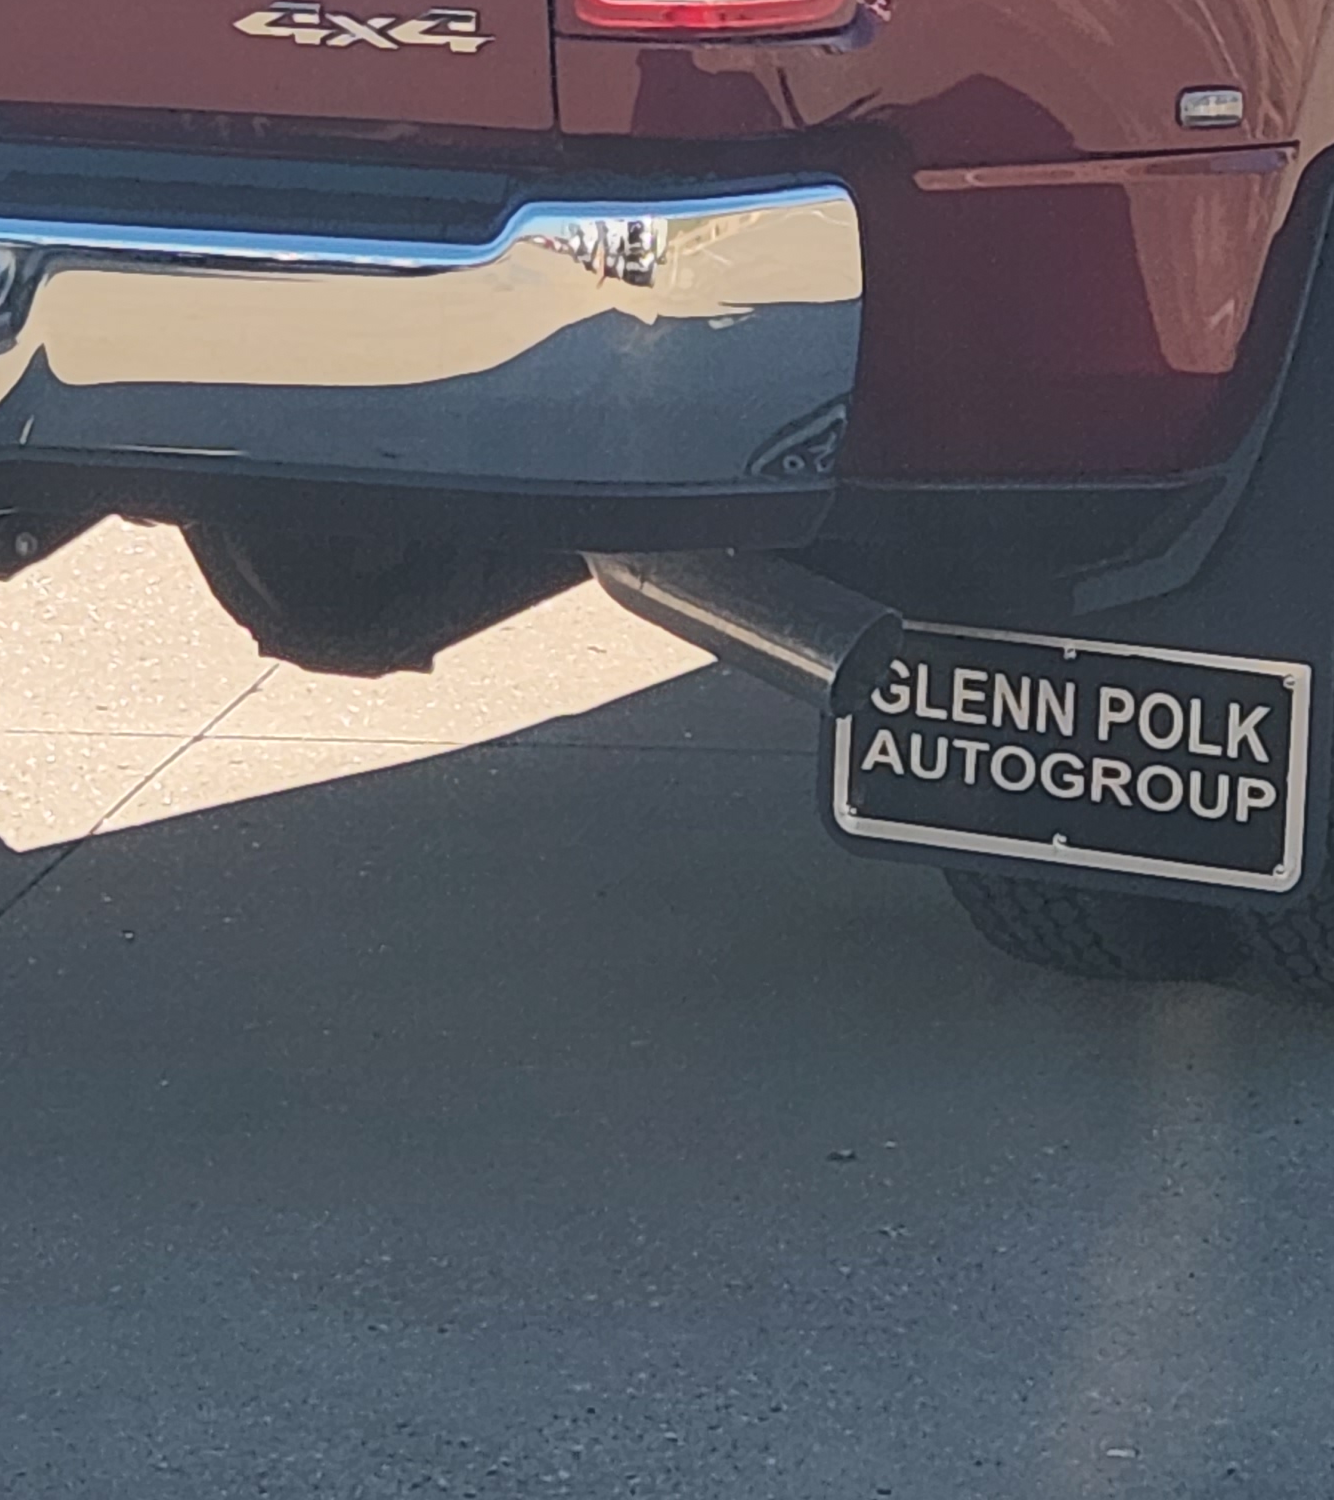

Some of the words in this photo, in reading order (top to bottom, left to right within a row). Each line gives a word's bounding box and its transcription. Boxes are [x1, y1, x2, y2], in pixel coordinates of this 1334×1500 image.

[870, 658, 1077, 738] GLENN
[1097, 685, 1273, 764] POLK
[860, 728, 1278, 823] AUTOGROUP
